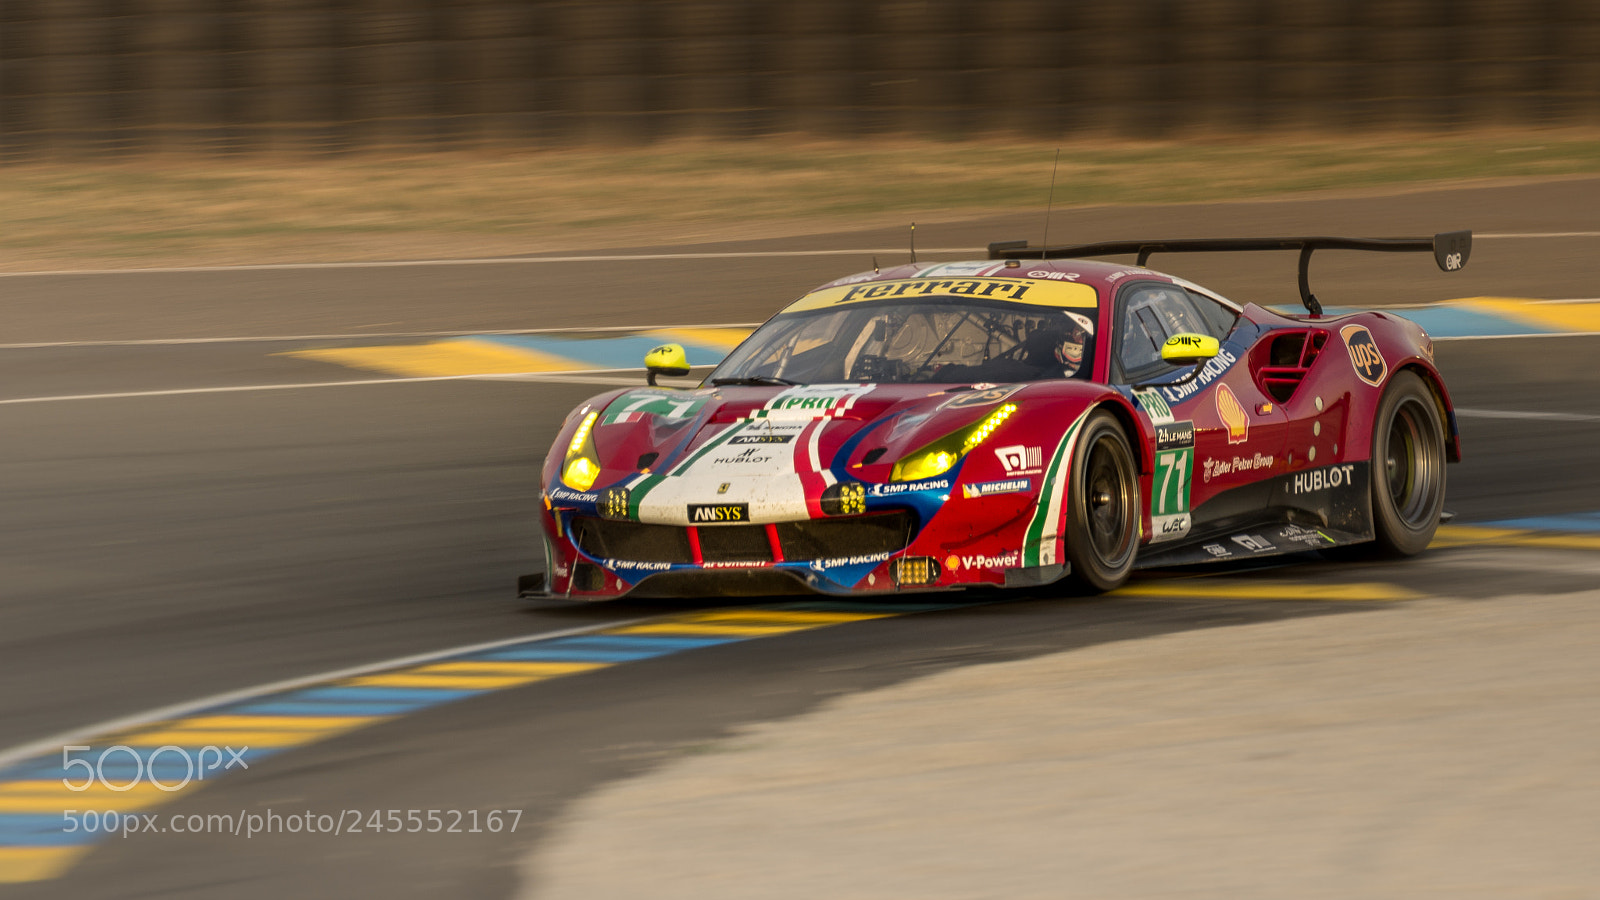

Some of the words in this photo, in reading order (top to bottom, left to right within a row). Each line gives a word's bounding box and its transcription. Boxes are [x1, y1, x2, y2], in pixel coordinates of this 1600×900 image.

[835, 278, 1035, 304] Ferrari
[1198, 348, 1237, 385] RACING
[622, 394, 696, 419] 71
[1137, 391, 1171, 419] PRO
[714, 456, 772, 464] HUBLOT
[1212, 460, 1231, 477] Adler
[1253, 452, 1274, 470] Group
[883, 484, 908, 493] SMP
[909, 479, 949, 492] RACING
[981, 480, 1028, 493] MICHELIN
[1159, 450, 1188, 514] 71
[1294, 464, 1354, 495] HUBLOT
[554, 490, 570, 499] SMP
[568, 492, 598, 502] RACING
[694, 506, 742, 521] ANSYS
[615, 560, 637, 570] SMP
[635, 562, 671, 571] RACING
[825, 557, 848, 569] SMP
[849, 552, 889, 566] RACING
[962, 554, 1018, 571] V-Power
